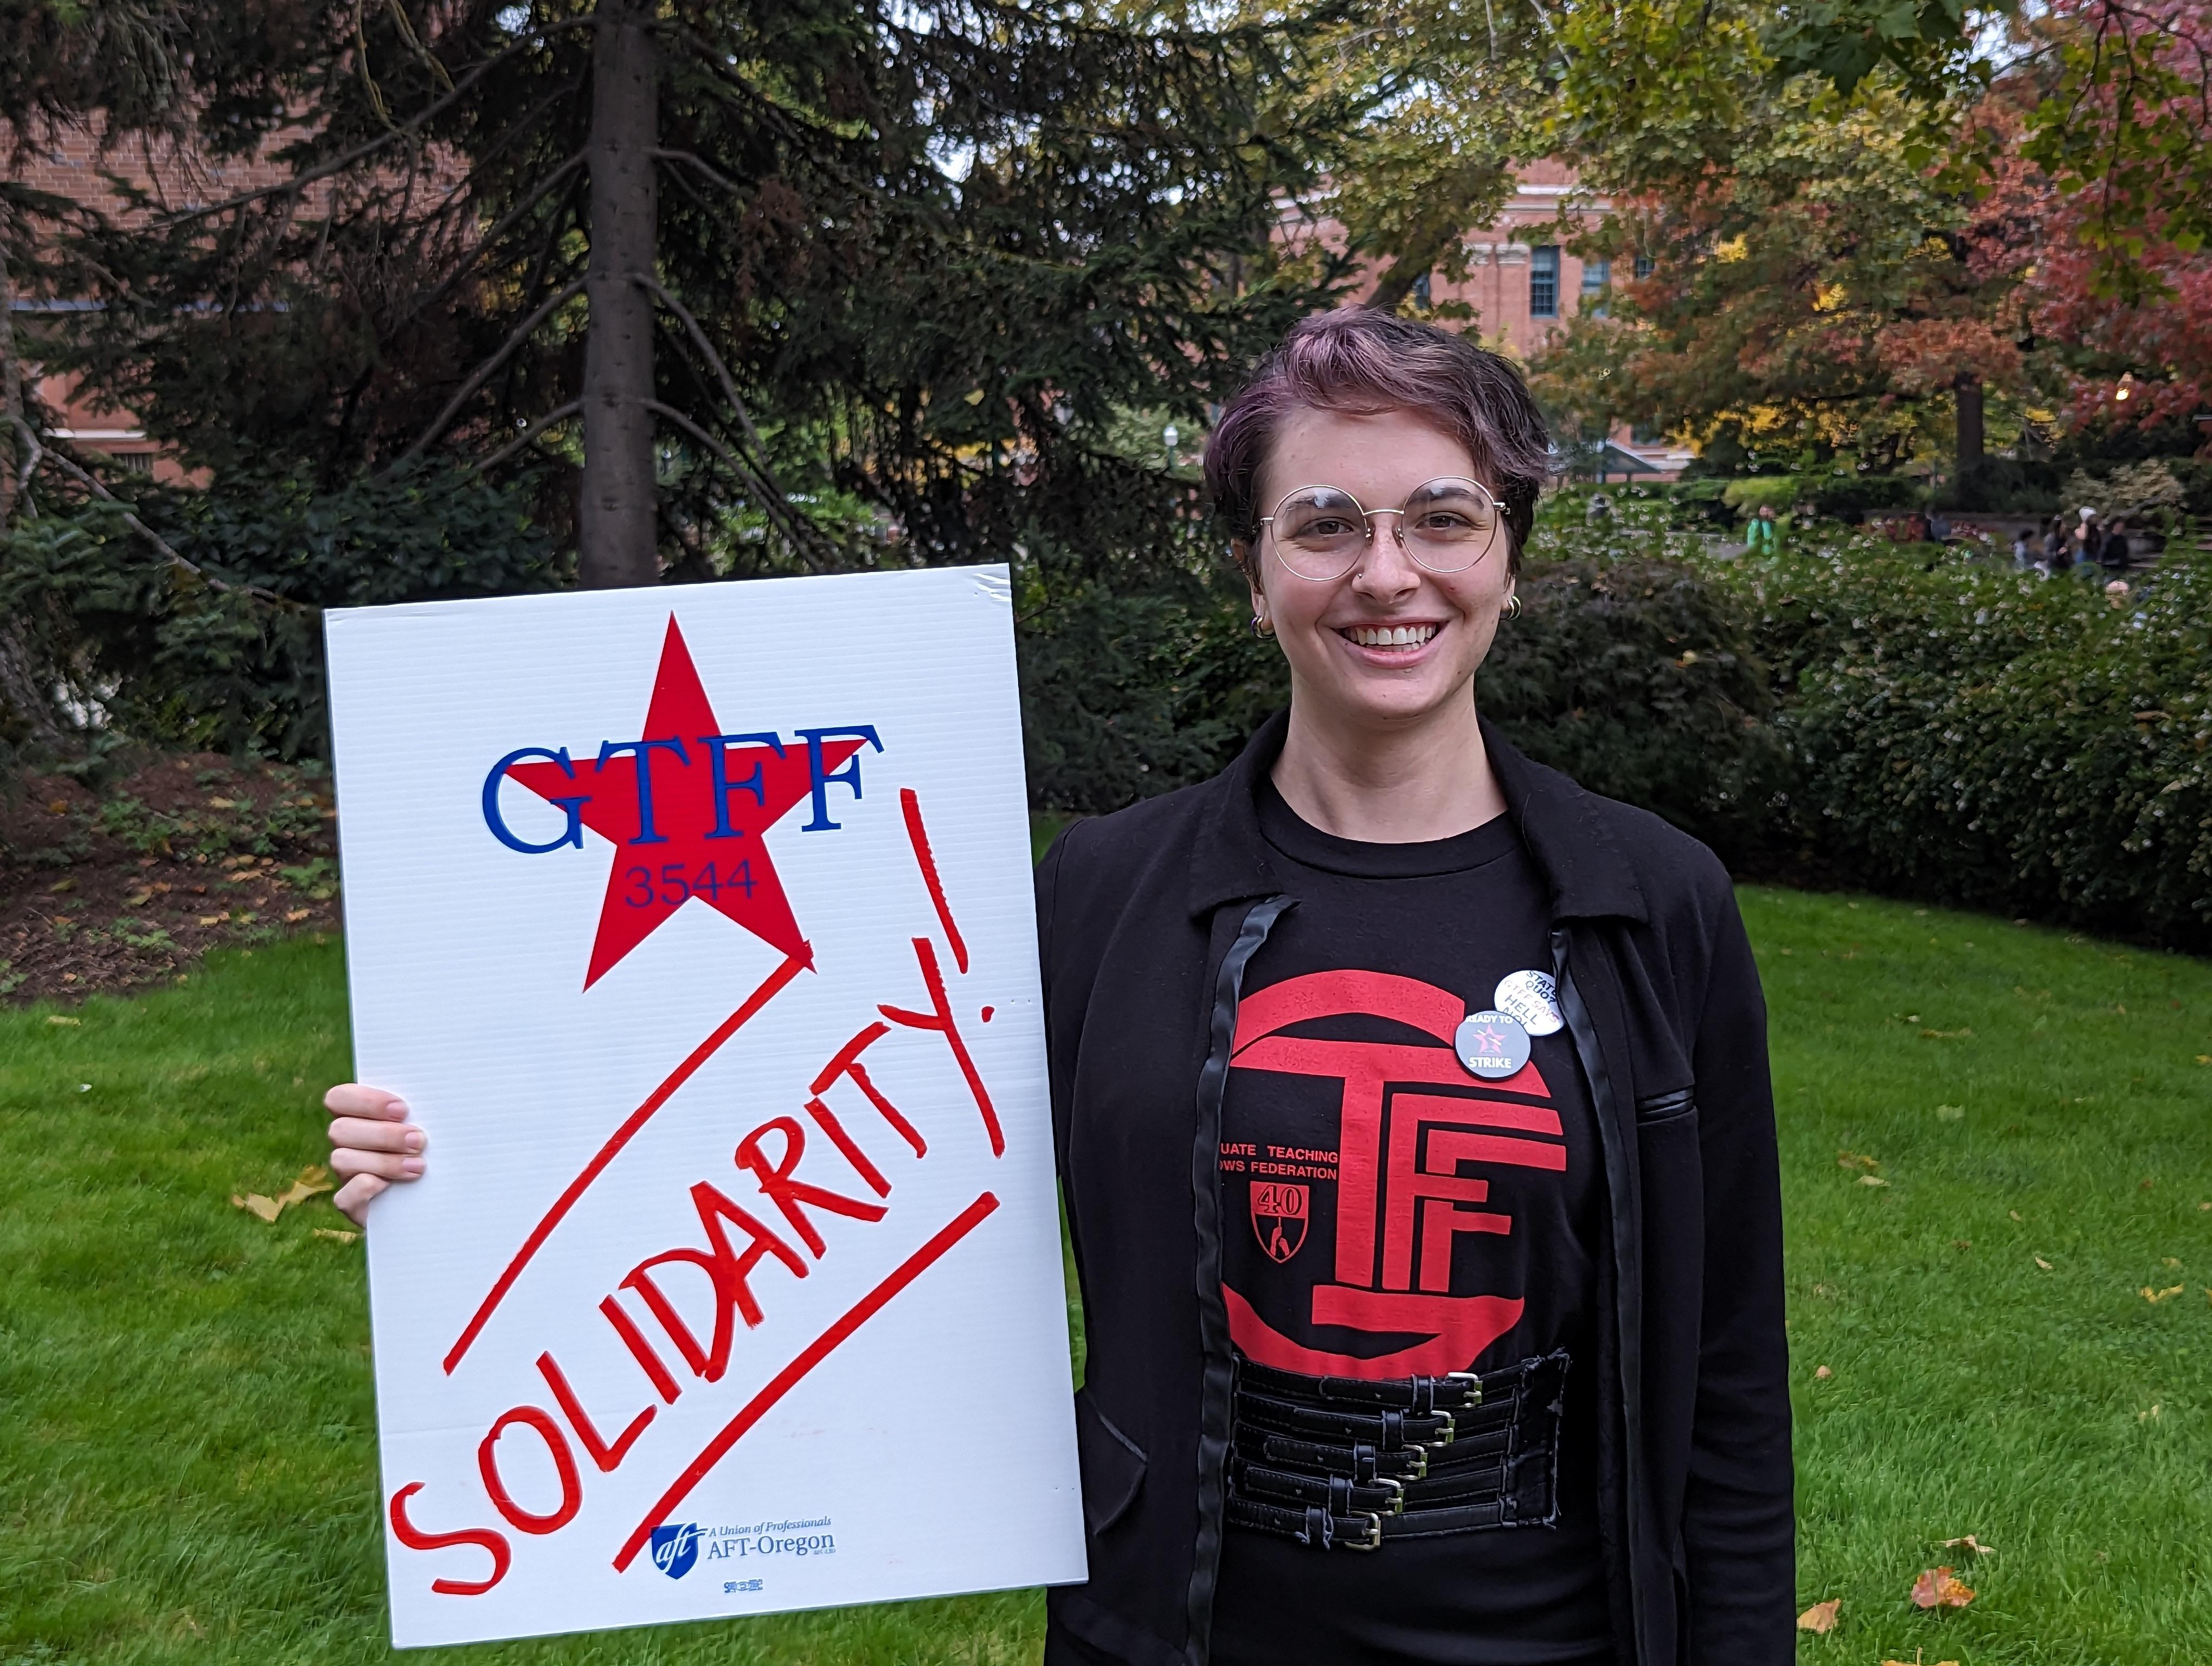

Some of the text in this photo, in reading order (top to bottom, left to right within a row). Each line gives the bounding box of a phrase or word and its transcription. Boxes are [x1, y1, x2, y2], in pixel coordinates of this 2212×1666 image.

[481, 724, 885, 855] GTFF
[624, 859, 758, 908] 3544
[1504, 980, 1532, 1000] GTFF
[1526, 981, 1555, 1003] QUO?
[1499, 1015, 1514, 1024] TO
[1504, 995, 1538, 1025] HELL
[1469, 1057, 1512, 1068] STRIKE
[1267, 1145, 1338, 1163] TEACHING
[1251, 1162, 1336, 1180] FEDERATION
[1257, 1185, 1302, 1215] 40
[709, 1516, 832, 1537] A Union of Professionals
[655, 1522, 708, 1574] aft
[707, 1534, 835, 1560] AFT-Oregon
